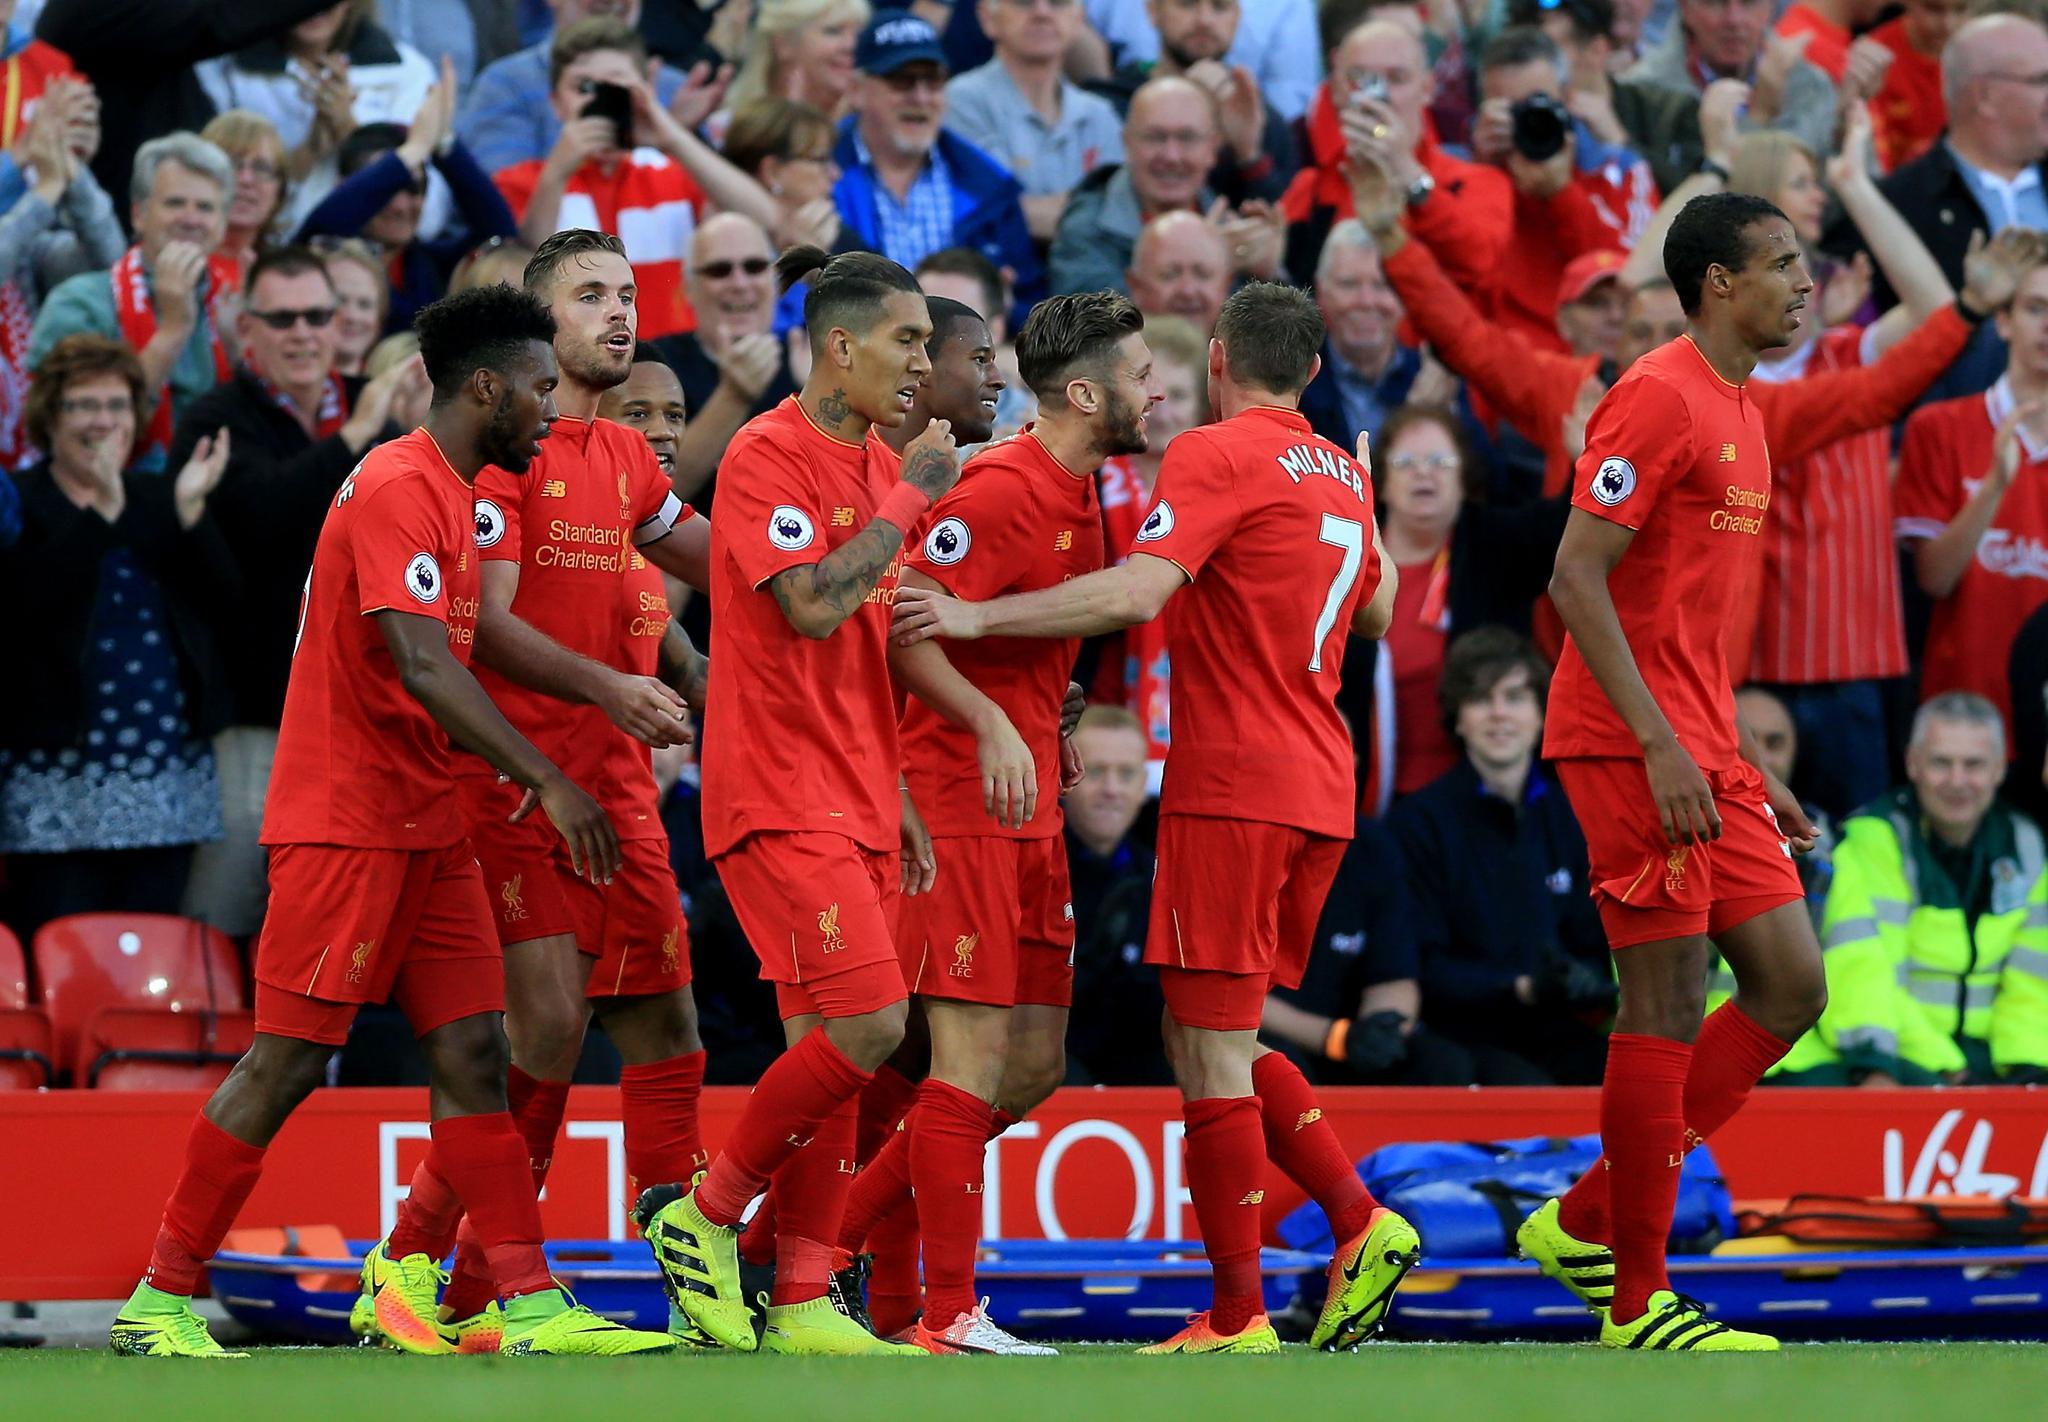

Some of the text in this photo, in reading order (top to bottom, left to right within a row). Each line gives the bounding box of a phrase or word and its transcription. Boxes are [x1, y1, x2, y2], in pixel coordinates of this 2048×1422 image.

[1277, 444, 1365, 503] MILNER
[549, 519, 620, 546] Standard
[535, 545, 619, 573] Chartered
[1308, 512, 1363, 673] 7
